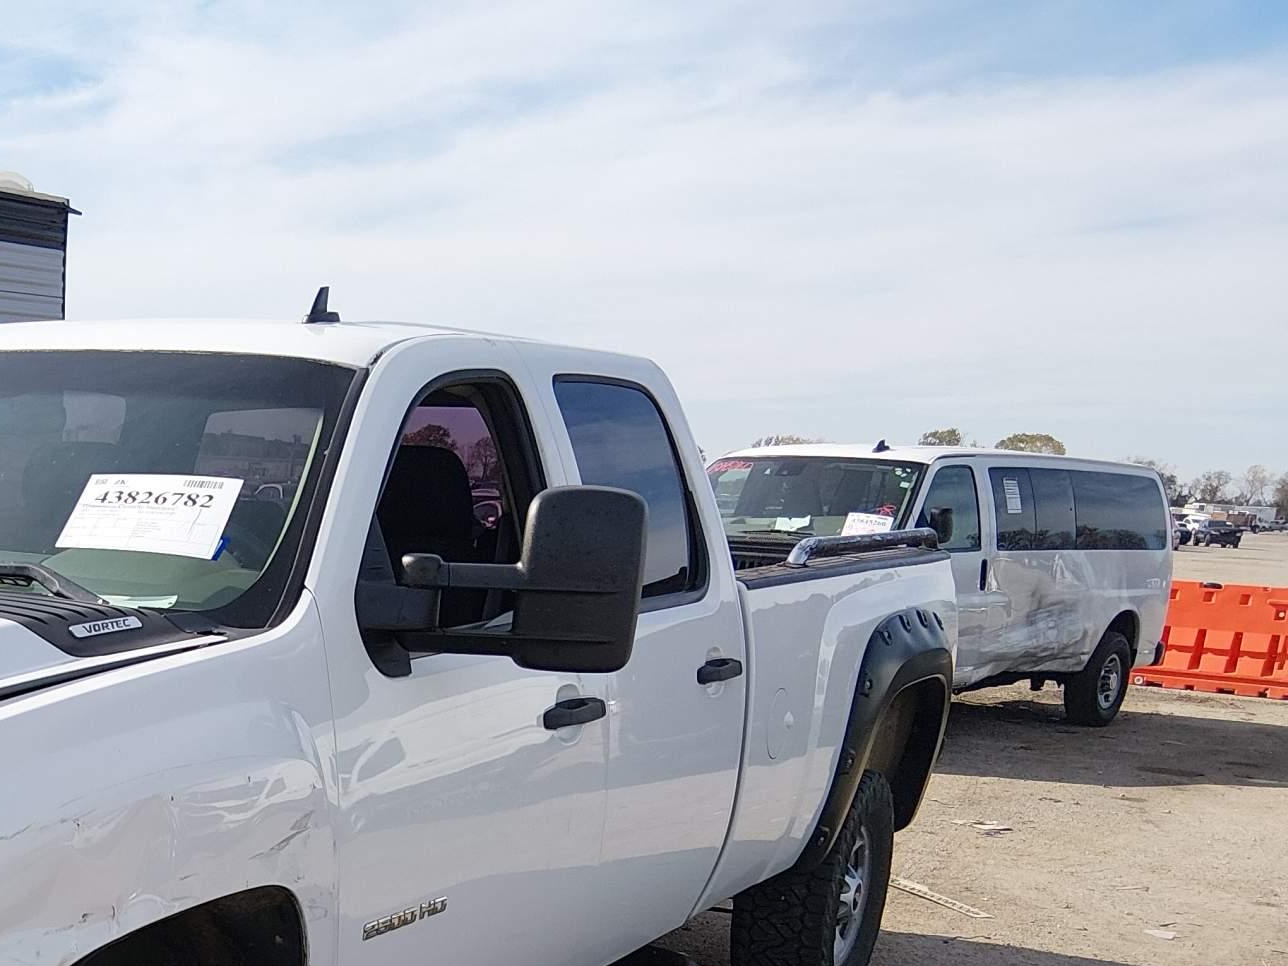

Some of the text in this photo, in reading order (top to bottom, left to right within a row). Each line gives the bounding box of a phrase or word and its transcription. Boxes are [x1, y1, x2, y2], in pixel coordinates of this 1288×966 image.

[94, 490, 215, 509] 43826782
[82, 618, 131, 634] VORTEC
[362, 896, 448, 941] 2500 HD
